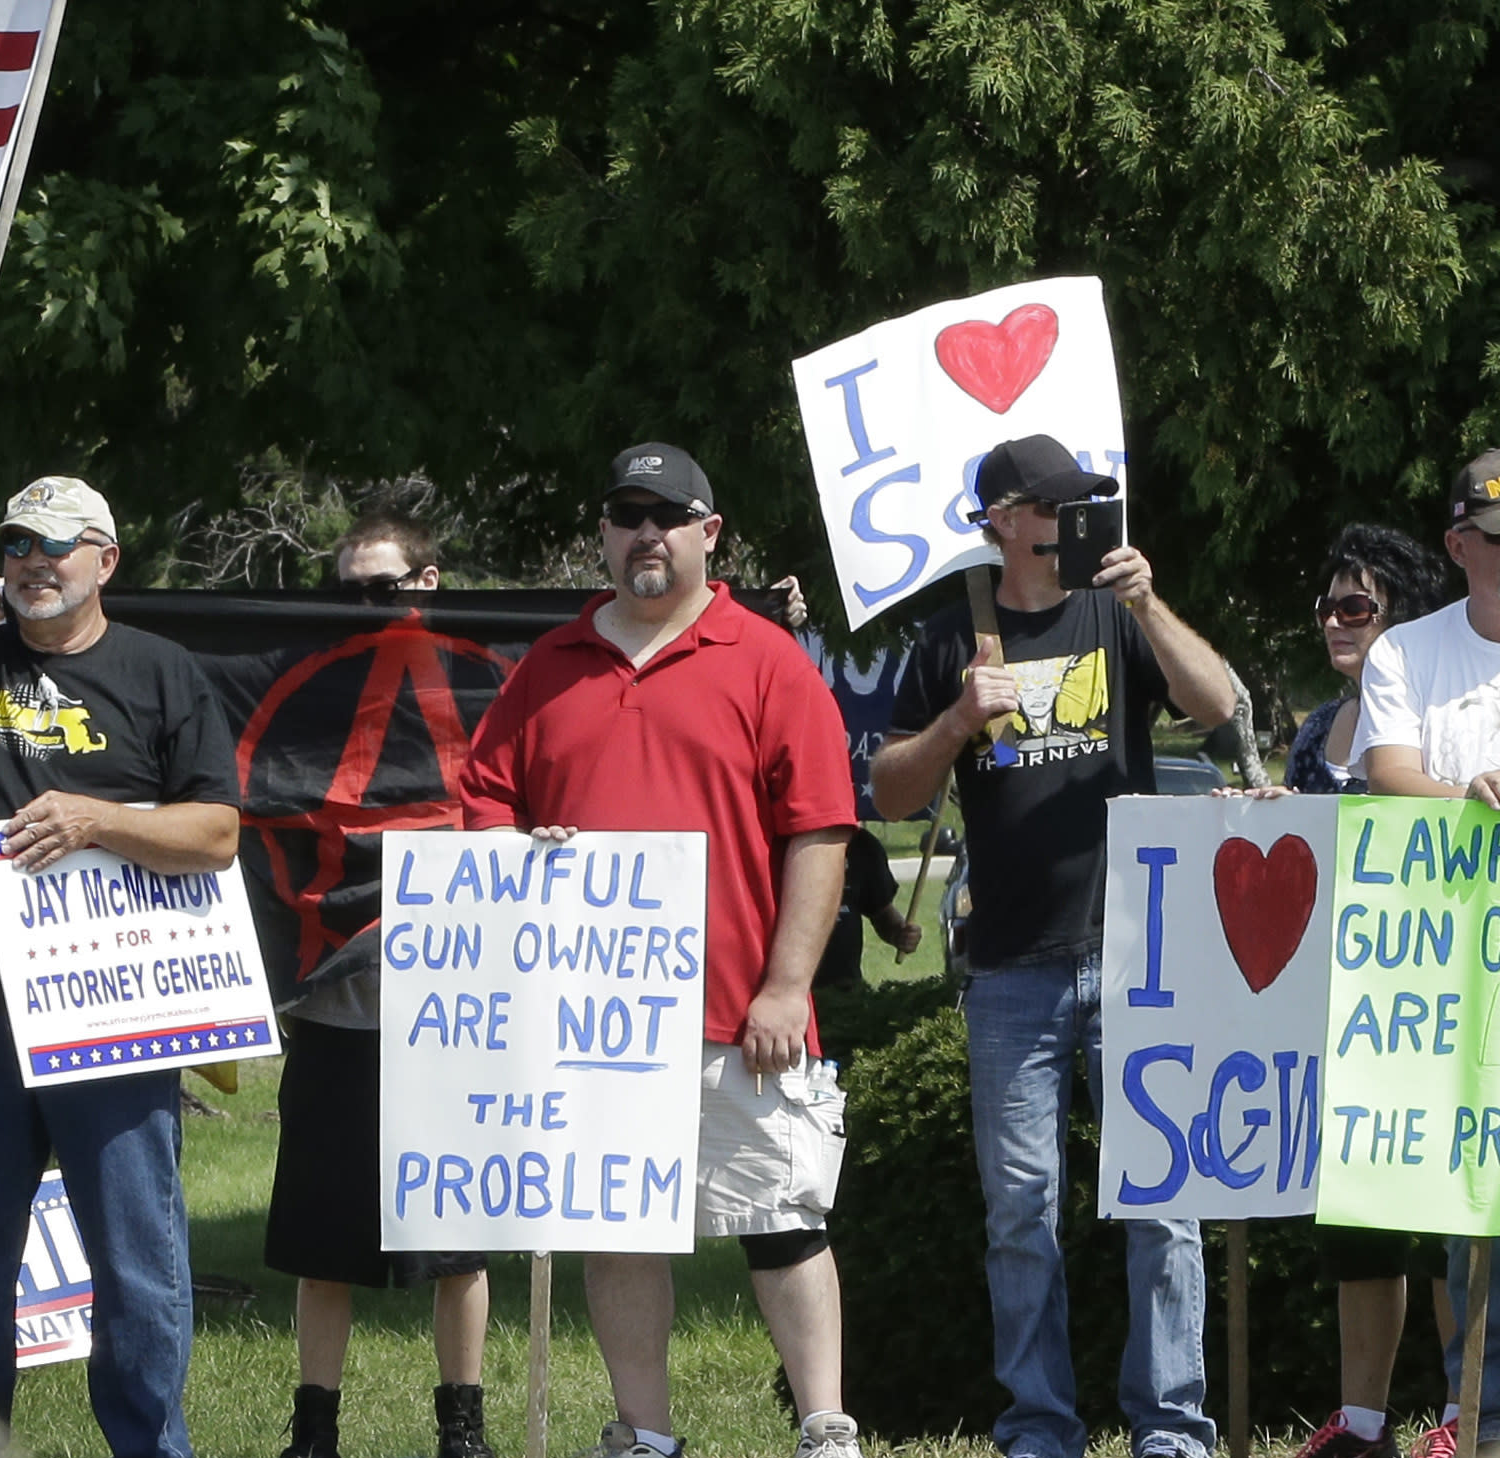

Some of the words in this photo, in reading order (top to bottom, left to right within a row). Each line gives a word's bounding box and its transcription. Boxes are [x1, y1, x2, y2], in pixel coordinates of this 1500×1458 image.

[824, 358, 897, 478] I
[20, 871, 70, 928] JAY
[80, 862, 223, 920] McMAHON
[396, 847, 663, 910] LAWFUL
[115, 928, 153, 948] FOR
[384, 921, 482, 971] GUN
[513, 921, 700, 982] OWNERS
[1127, 847, 1178, 1008] I
[1336, 904, 1454, 970] GUN
[26, 963, 145, 1015] ATTORNEY
[153, 951, 253, 998] GENERAL
[408, 991, 512, 1050] ARE
[557, 995, 679, 1058] NOT
[1336, 992, 1461, 1057] ARE
[467, 1090, 569, 1131] THE
[1334, 1105, 1427, 1165] THE
[396, 1151, 682, 1223] PROBLEM
